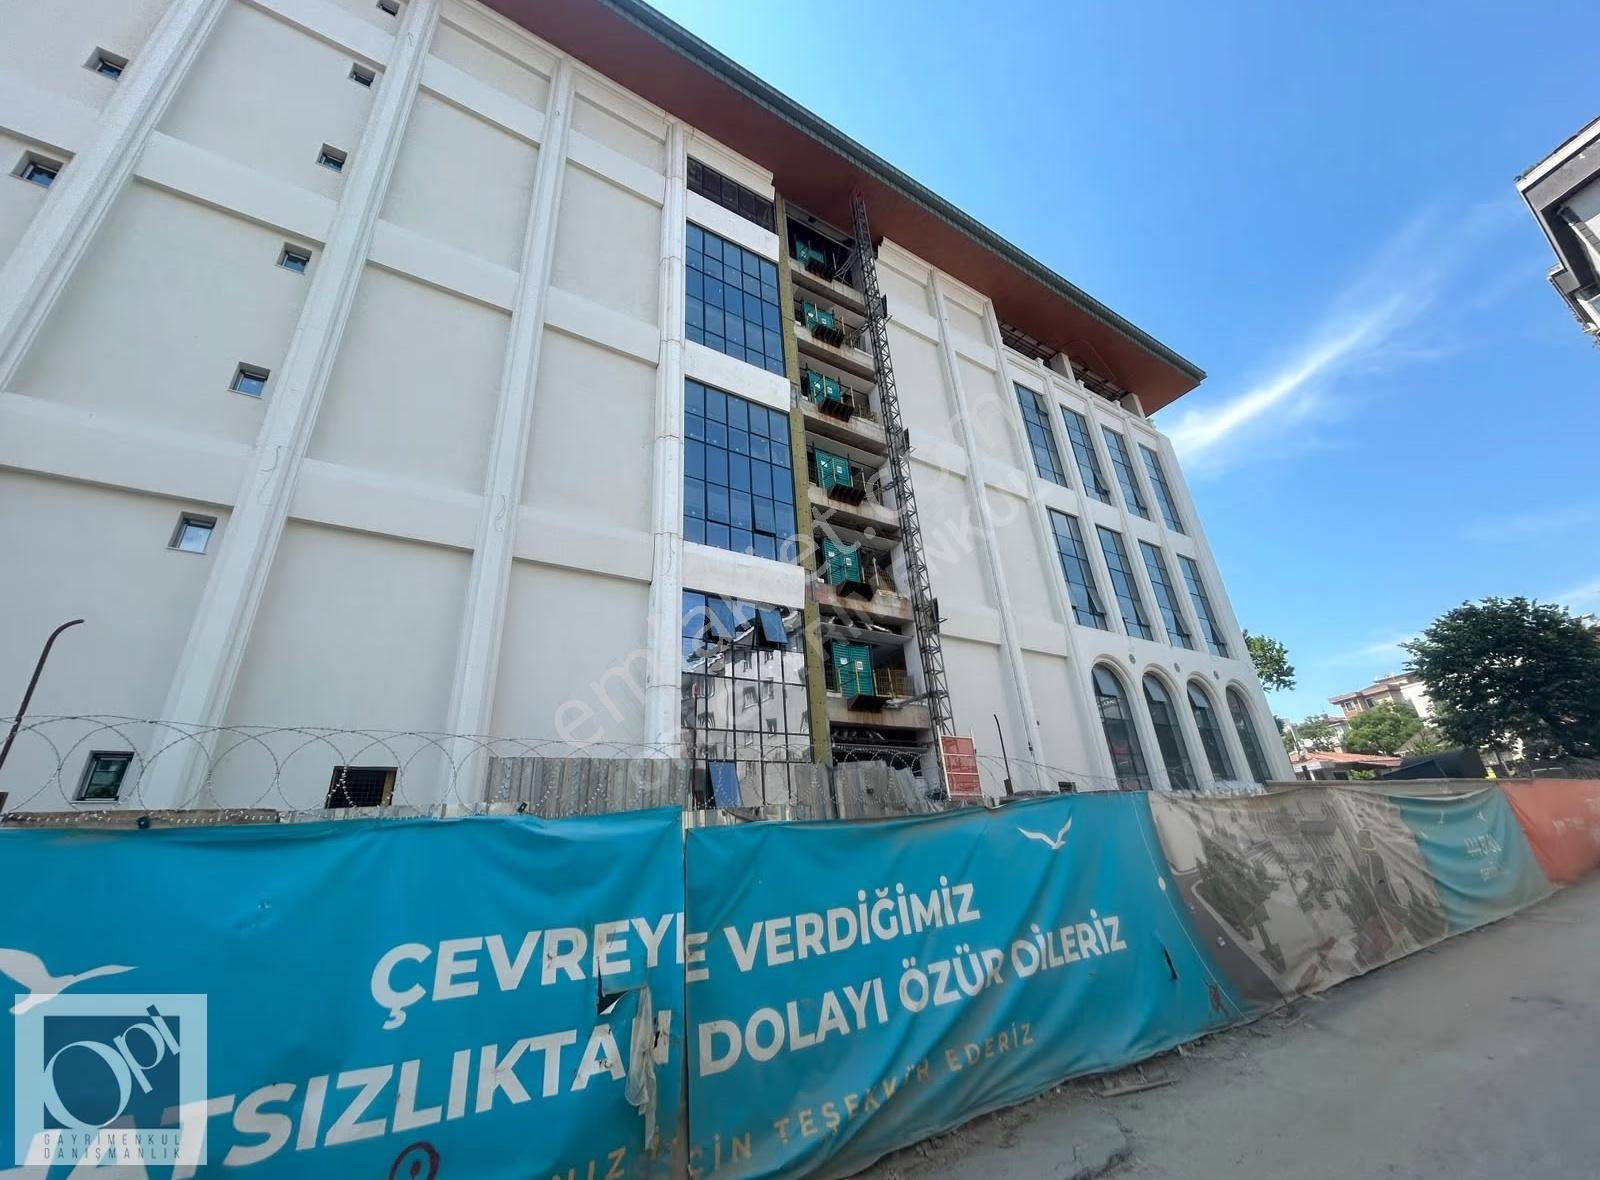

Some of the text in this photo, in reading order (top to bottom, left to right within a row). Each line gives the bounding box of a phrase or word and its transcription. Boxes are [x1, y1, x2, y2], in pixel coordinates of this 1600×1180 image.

[723, 875, 981, 973] VERDİĞİMİZ
[699, 977, 889, 1077] DOLAYI
[900, 943, 1004, 1013] ÖZÜR
[1011, 908, 1127, 978] DİLERİZ
[945, 1022, 1034, 1072] EDERİZ
